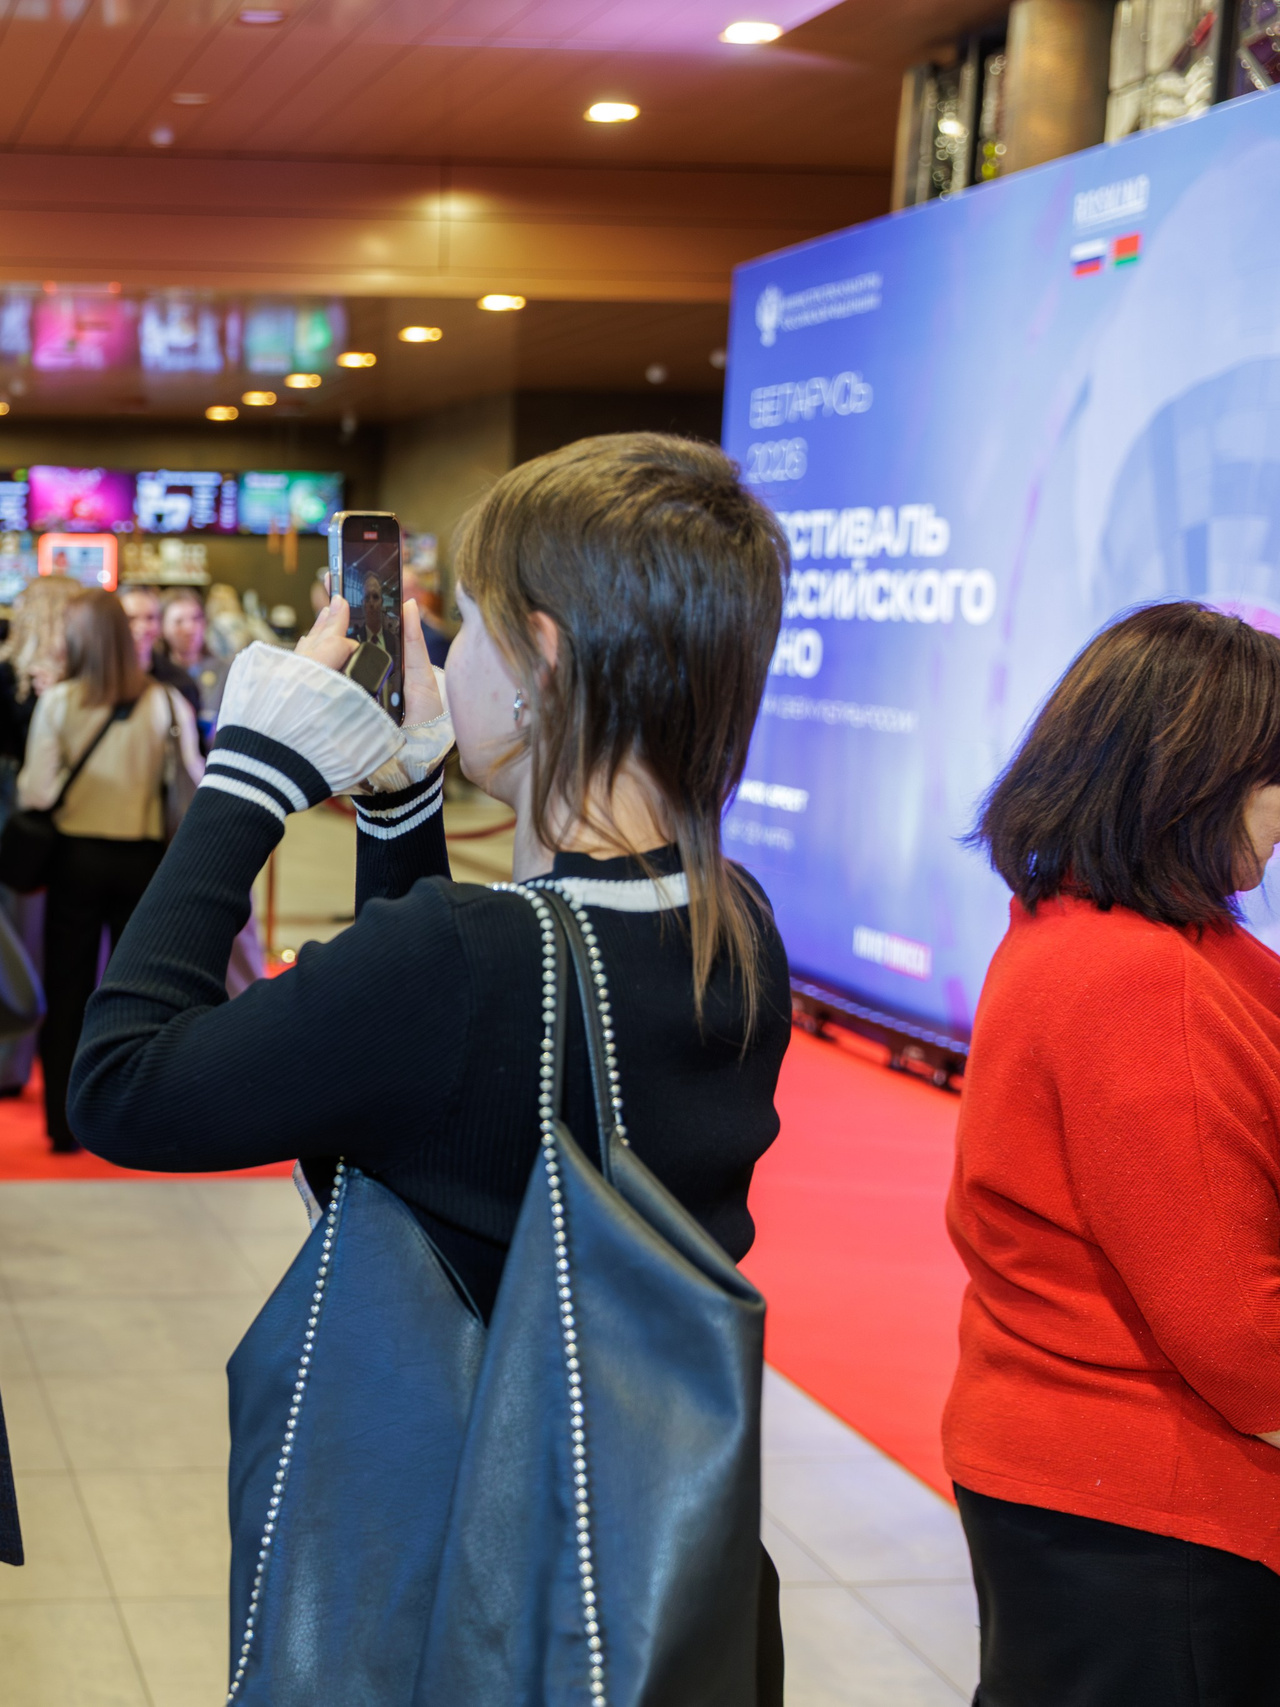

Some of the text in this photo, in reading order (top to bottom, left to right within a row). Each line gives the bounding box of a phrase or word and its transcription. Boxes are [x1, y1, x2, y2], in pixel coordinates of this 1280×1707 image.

[749, 371, 873, 429] БЕЛАРУСЬ
[746, 437, 808, 483] 2026
[776, 503, 950, 560] СТИВАЛЬ
[783, 557, 996, 625] ССИЙСКОГО
[770, 627, 823, 678] НО
